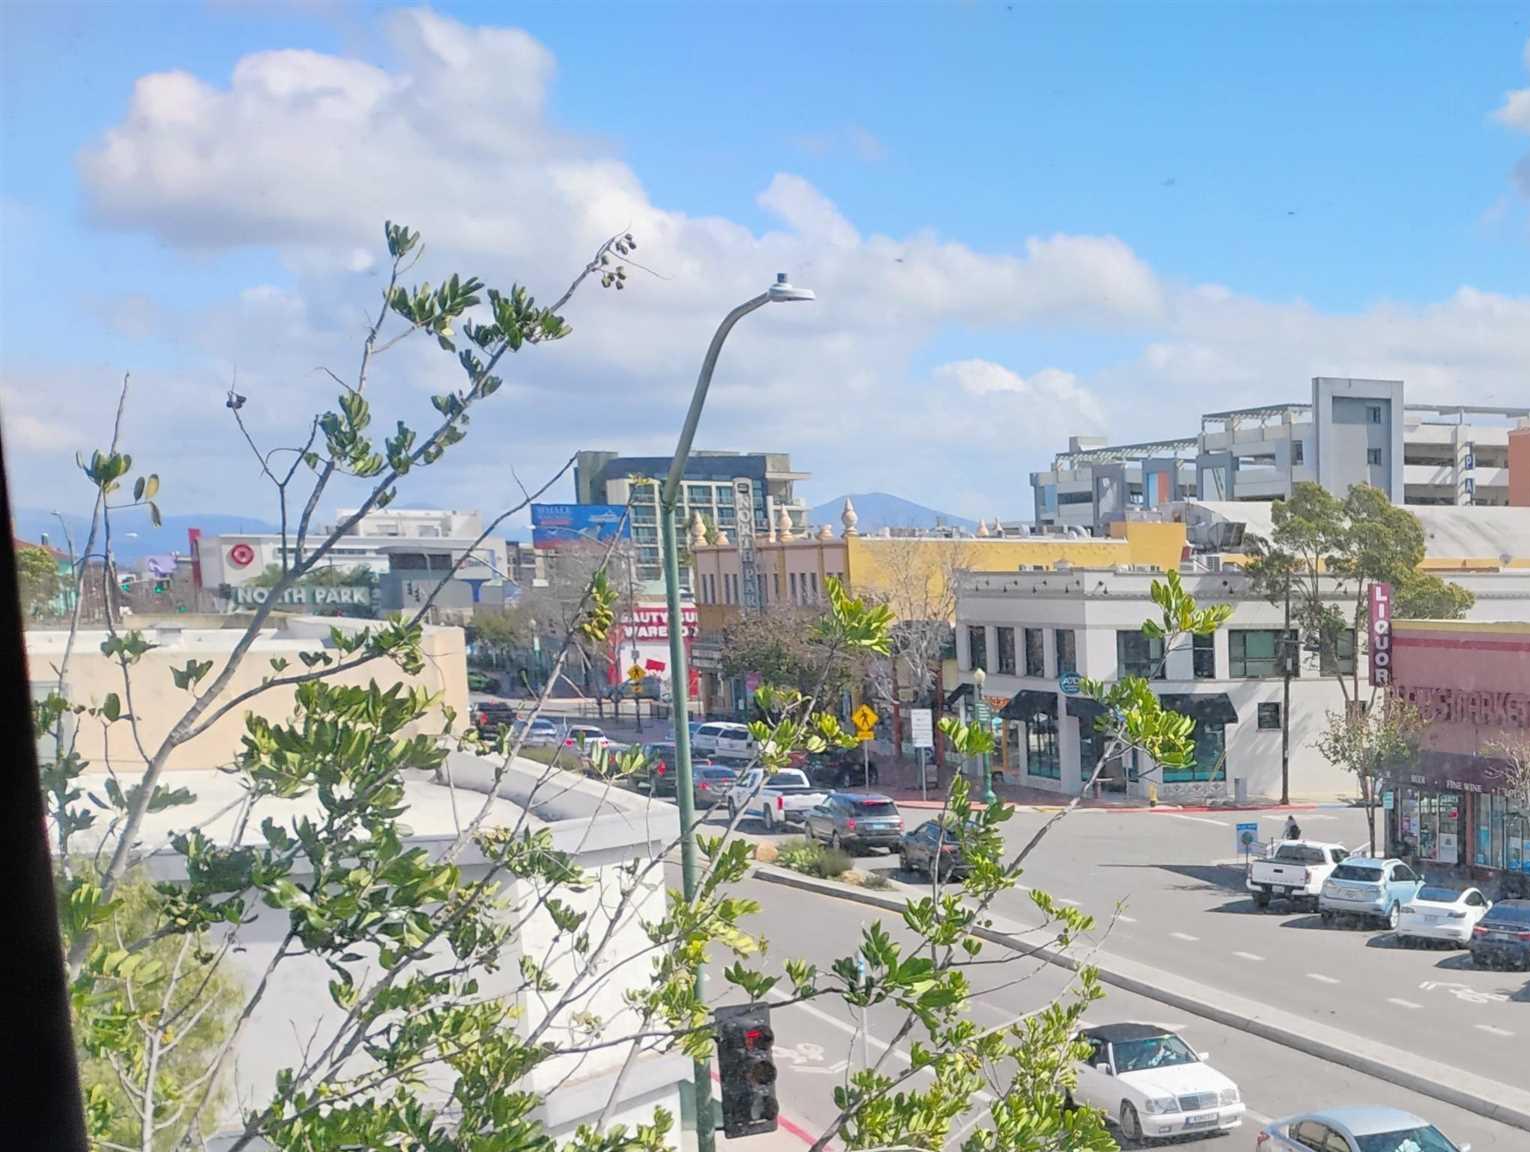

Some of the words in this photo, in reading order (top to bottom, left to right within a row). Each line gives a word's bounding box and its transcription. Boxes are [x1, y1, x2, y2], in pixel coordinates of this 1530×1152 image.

[237, 586, 306, 603] NOTH
[314, 586, 369, 604] PARK
[1374, 587, 1389, 682] LIQUOR
[1446, 779, 1462, 791] FINE
[1463, 783, 1482, 793] WINE
